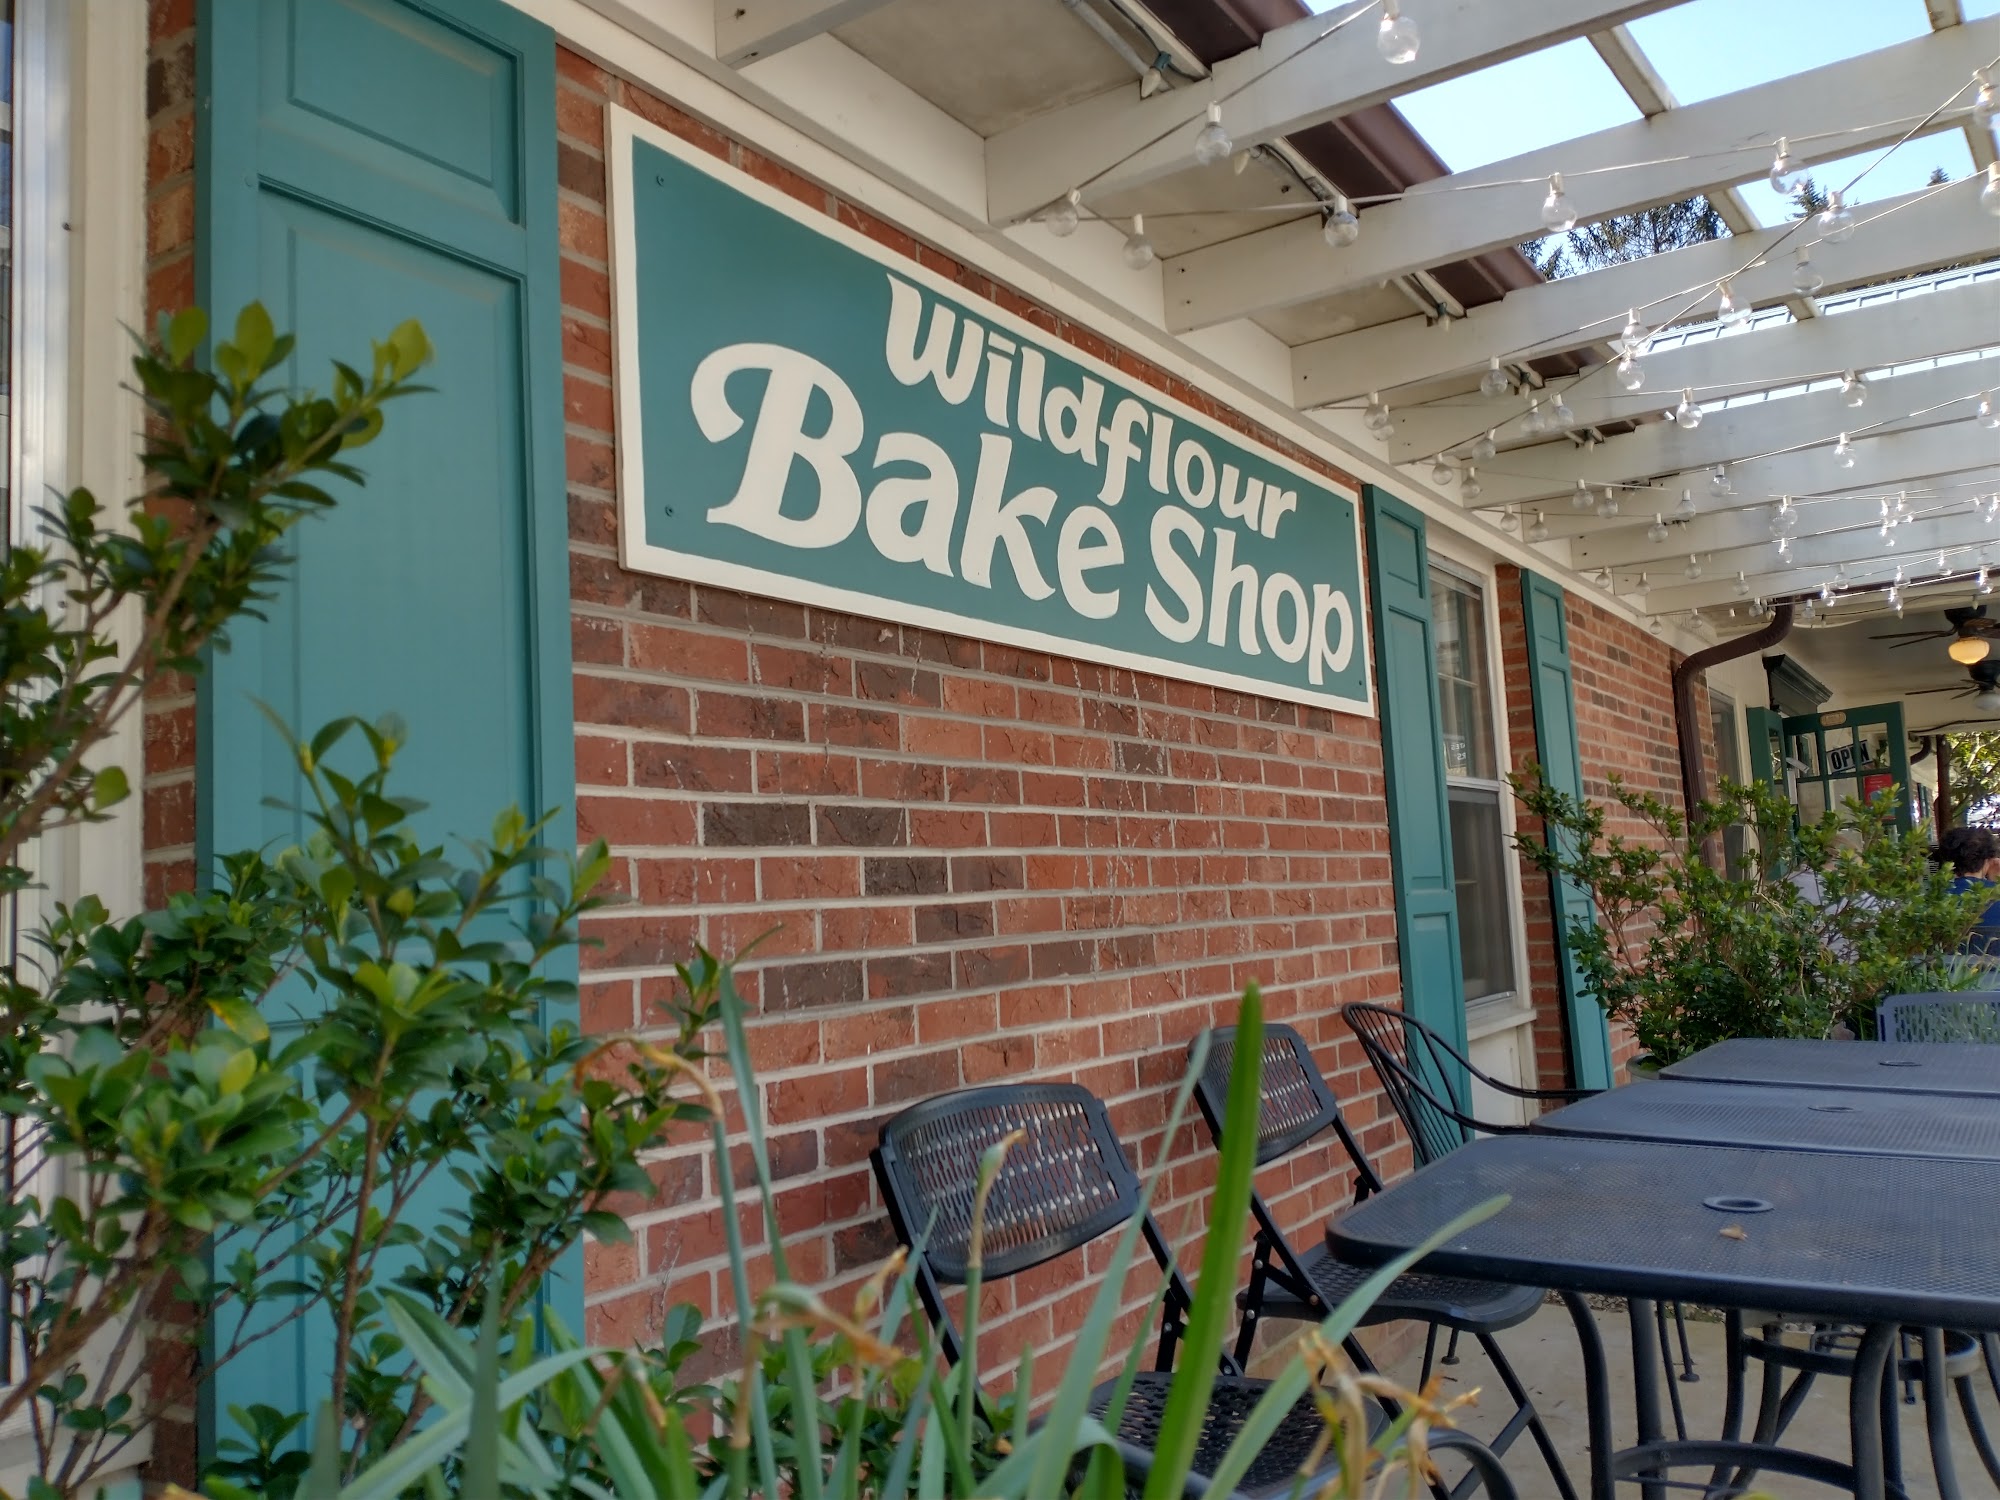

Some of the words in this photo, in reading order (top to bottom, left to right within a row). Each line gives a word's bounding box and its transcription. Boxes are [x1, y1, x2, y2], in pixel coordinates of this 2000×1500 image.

[690, 342, 1125, 619] Bake
[1145, 505, 1354, 685] Shop
[886, 273, 1297, 540] Wildflour
[1831, 743, 1870, 769] OPN
